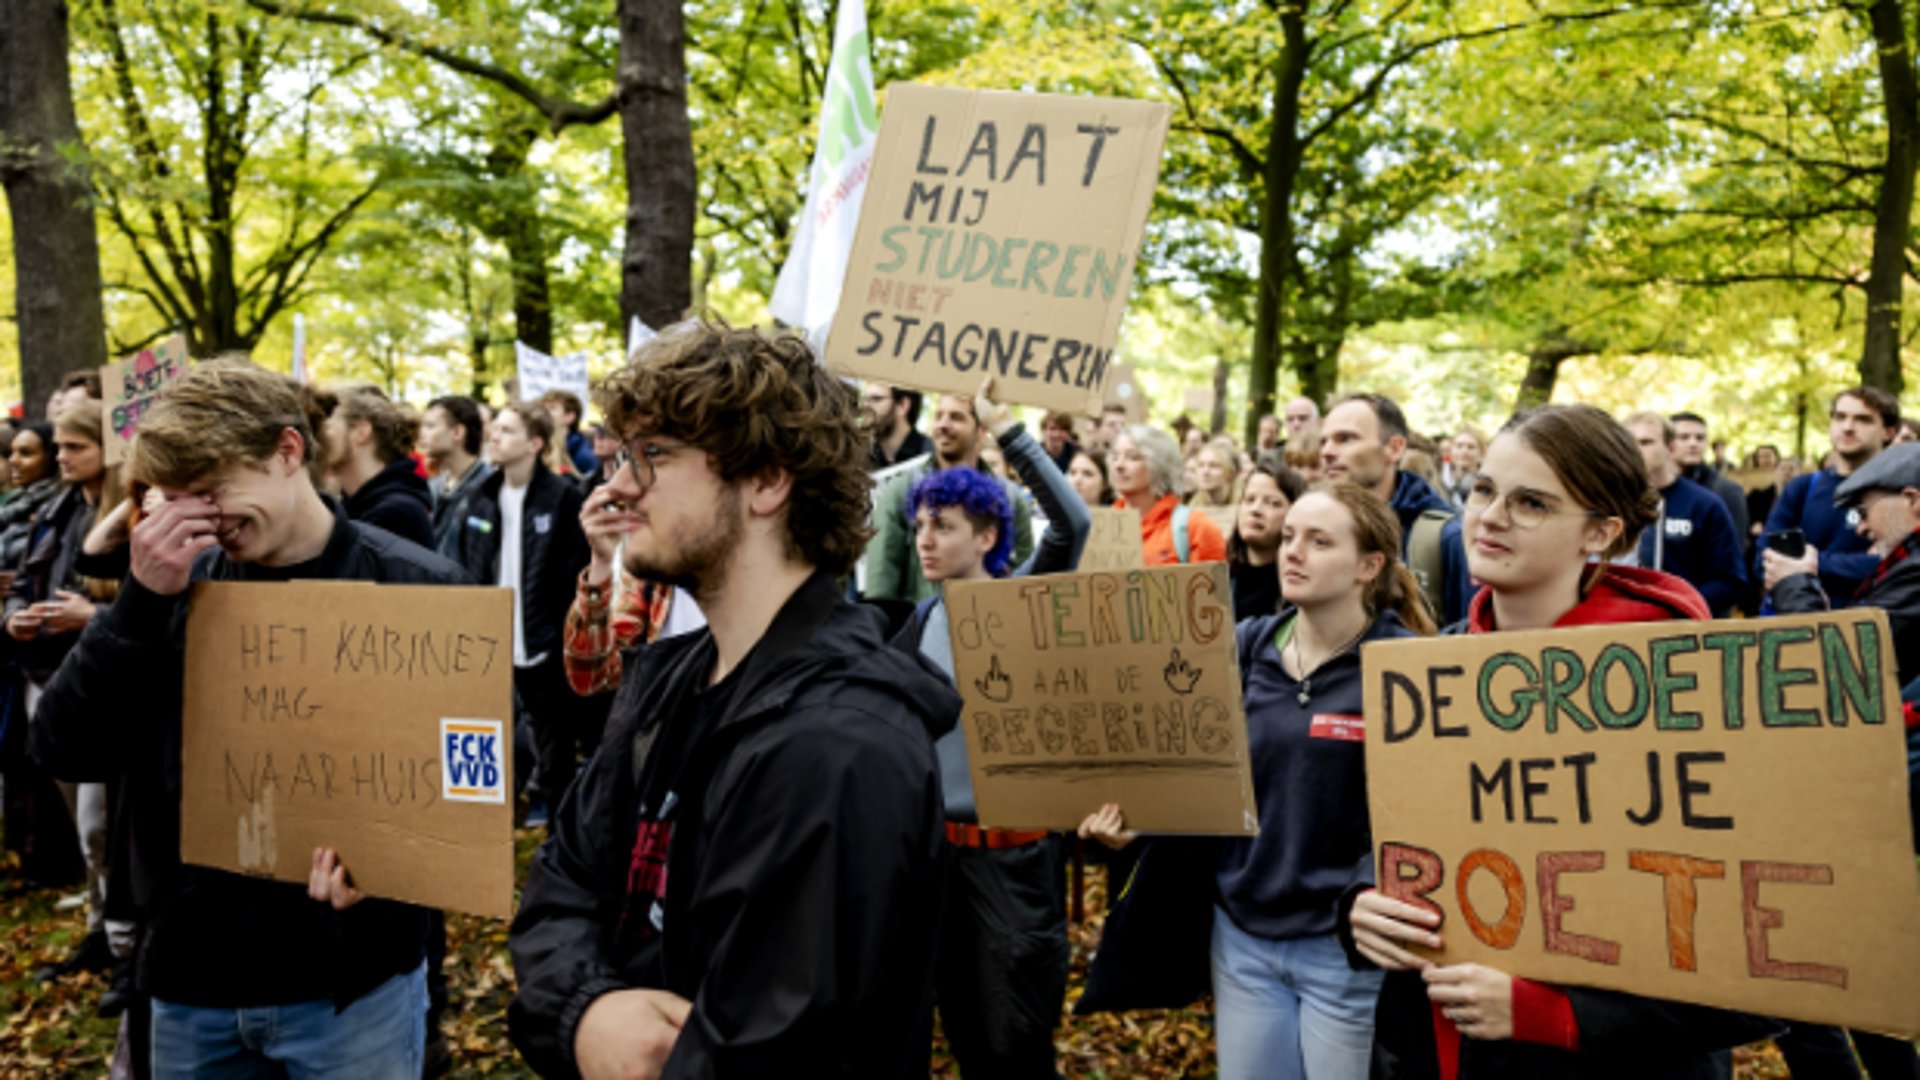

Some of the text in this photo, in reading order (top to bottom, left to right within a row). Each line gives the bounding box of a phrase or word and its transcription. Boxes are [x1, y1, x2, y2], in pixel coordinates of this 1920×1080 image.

[916, 115, 1120, 187] LAAT
[903, 181, 988, 225] MIJ
[875, 225, 1127, 300] STUDEREN
[866, 277, 953, 315] NIET
[240, 621, 498, 679] HET KABINET
[240, 684, 322, 722] MAG
[1034, 665, 1142, 695] AAN DE
[1382, 621, 1885, 743] DE GROETEN
[446, 732, 496, 762] FCK
[448, 761, 499, 787] VVD
[1469, 751, 1734, 830] MET JE
[1380, 841, 1848, 991] BOETE
